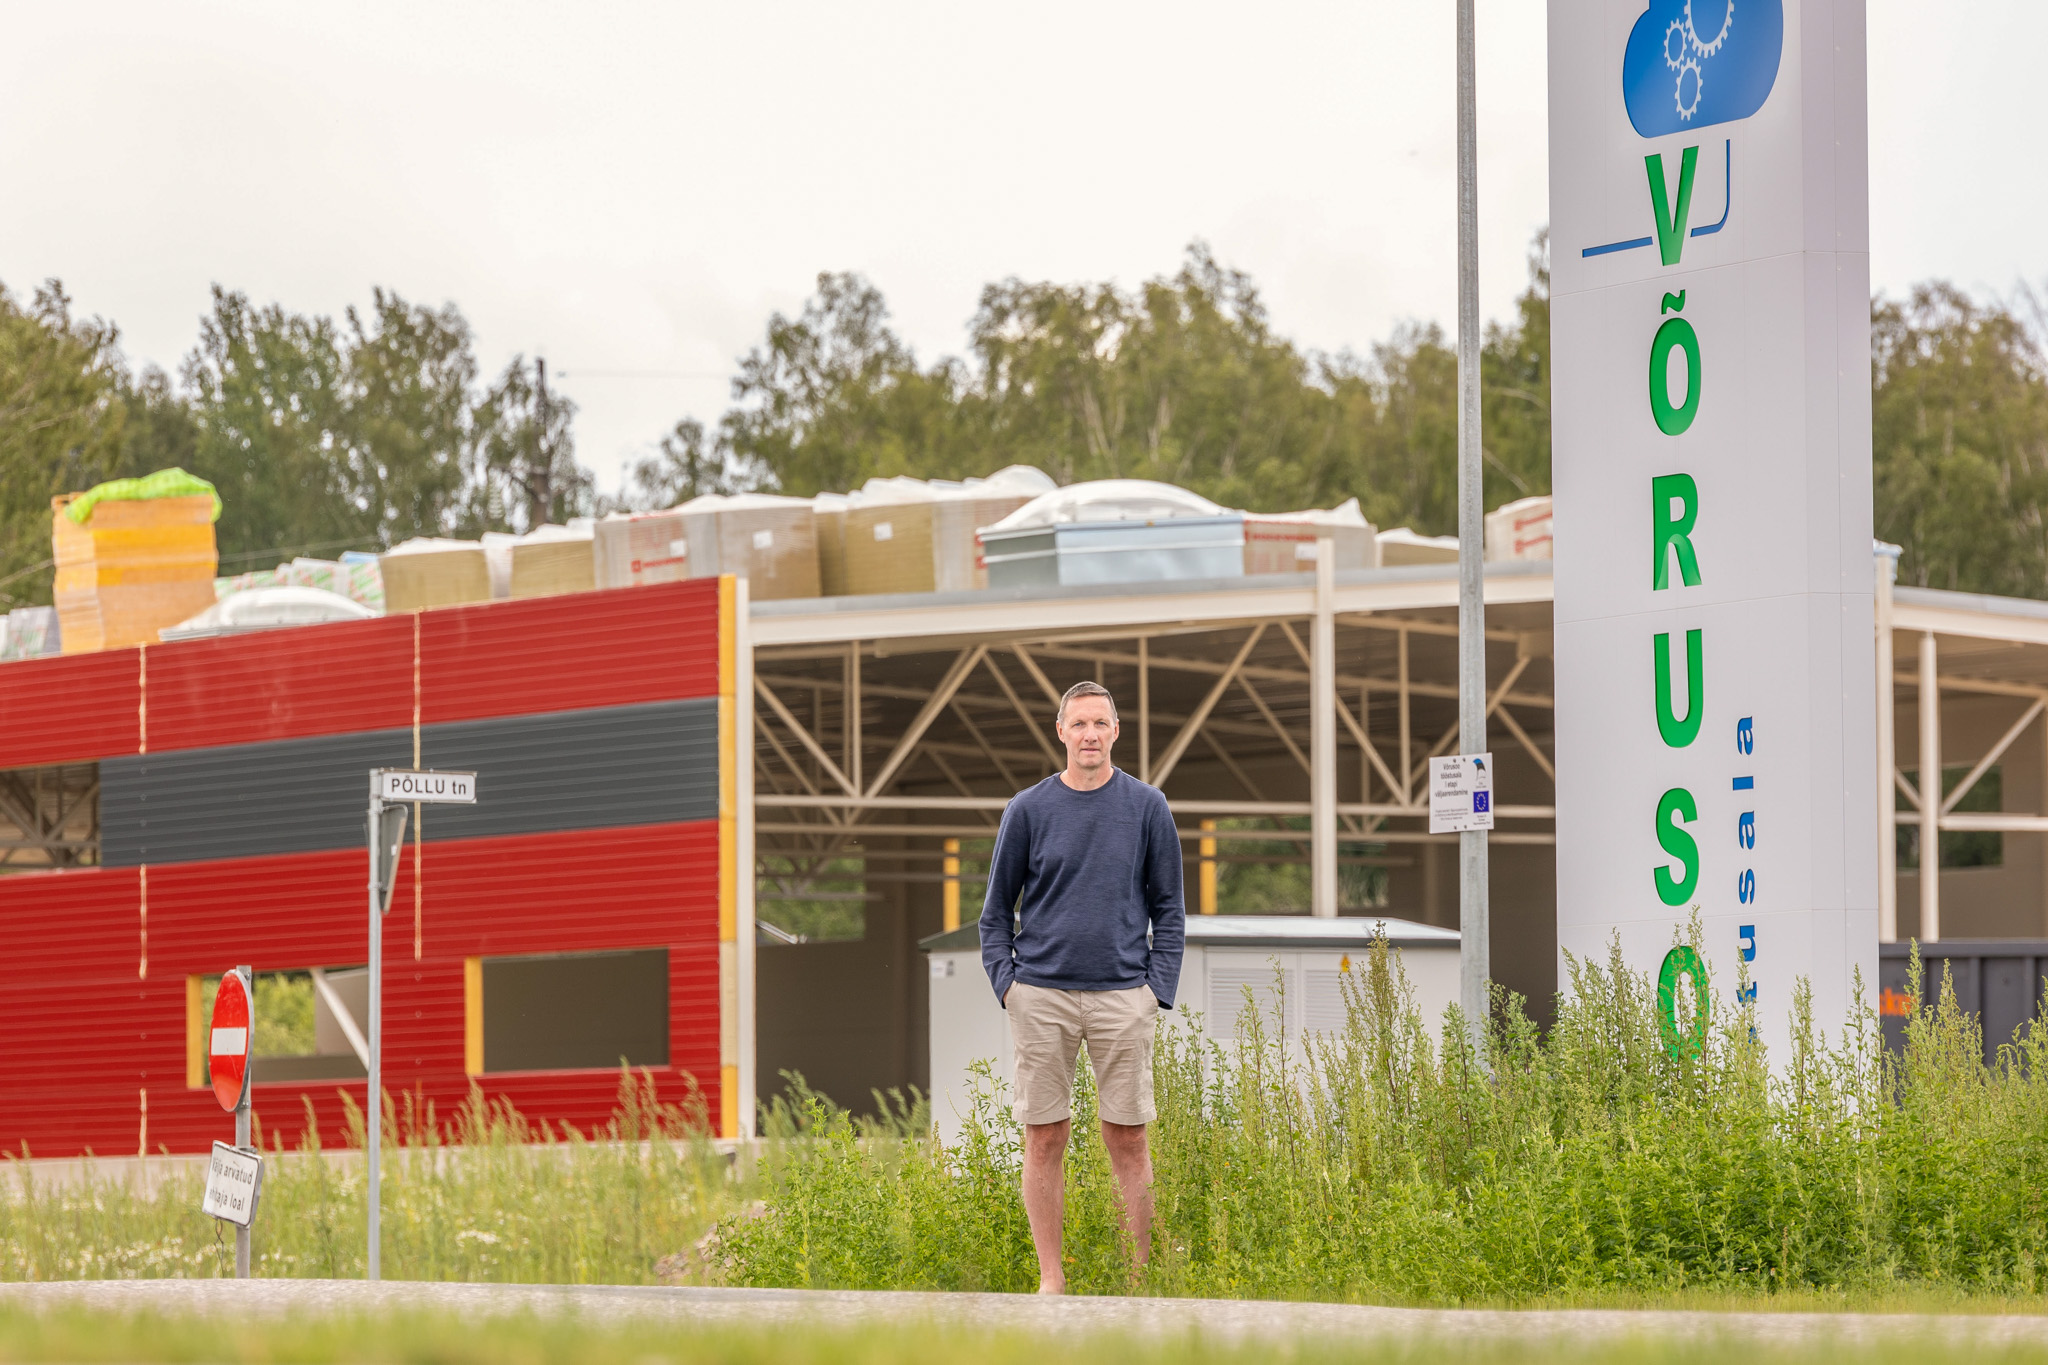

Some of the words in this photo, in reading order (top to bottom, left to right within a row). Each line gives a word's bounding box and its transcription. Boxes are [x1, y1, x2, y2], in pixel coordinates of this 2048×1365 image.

[391, 774, 445, 794] PÕLLU
[452, 780, 467, 795] tn
[223, 1165, 254, 1185] arvatud
[229, 1193, 245, 1211] loal
